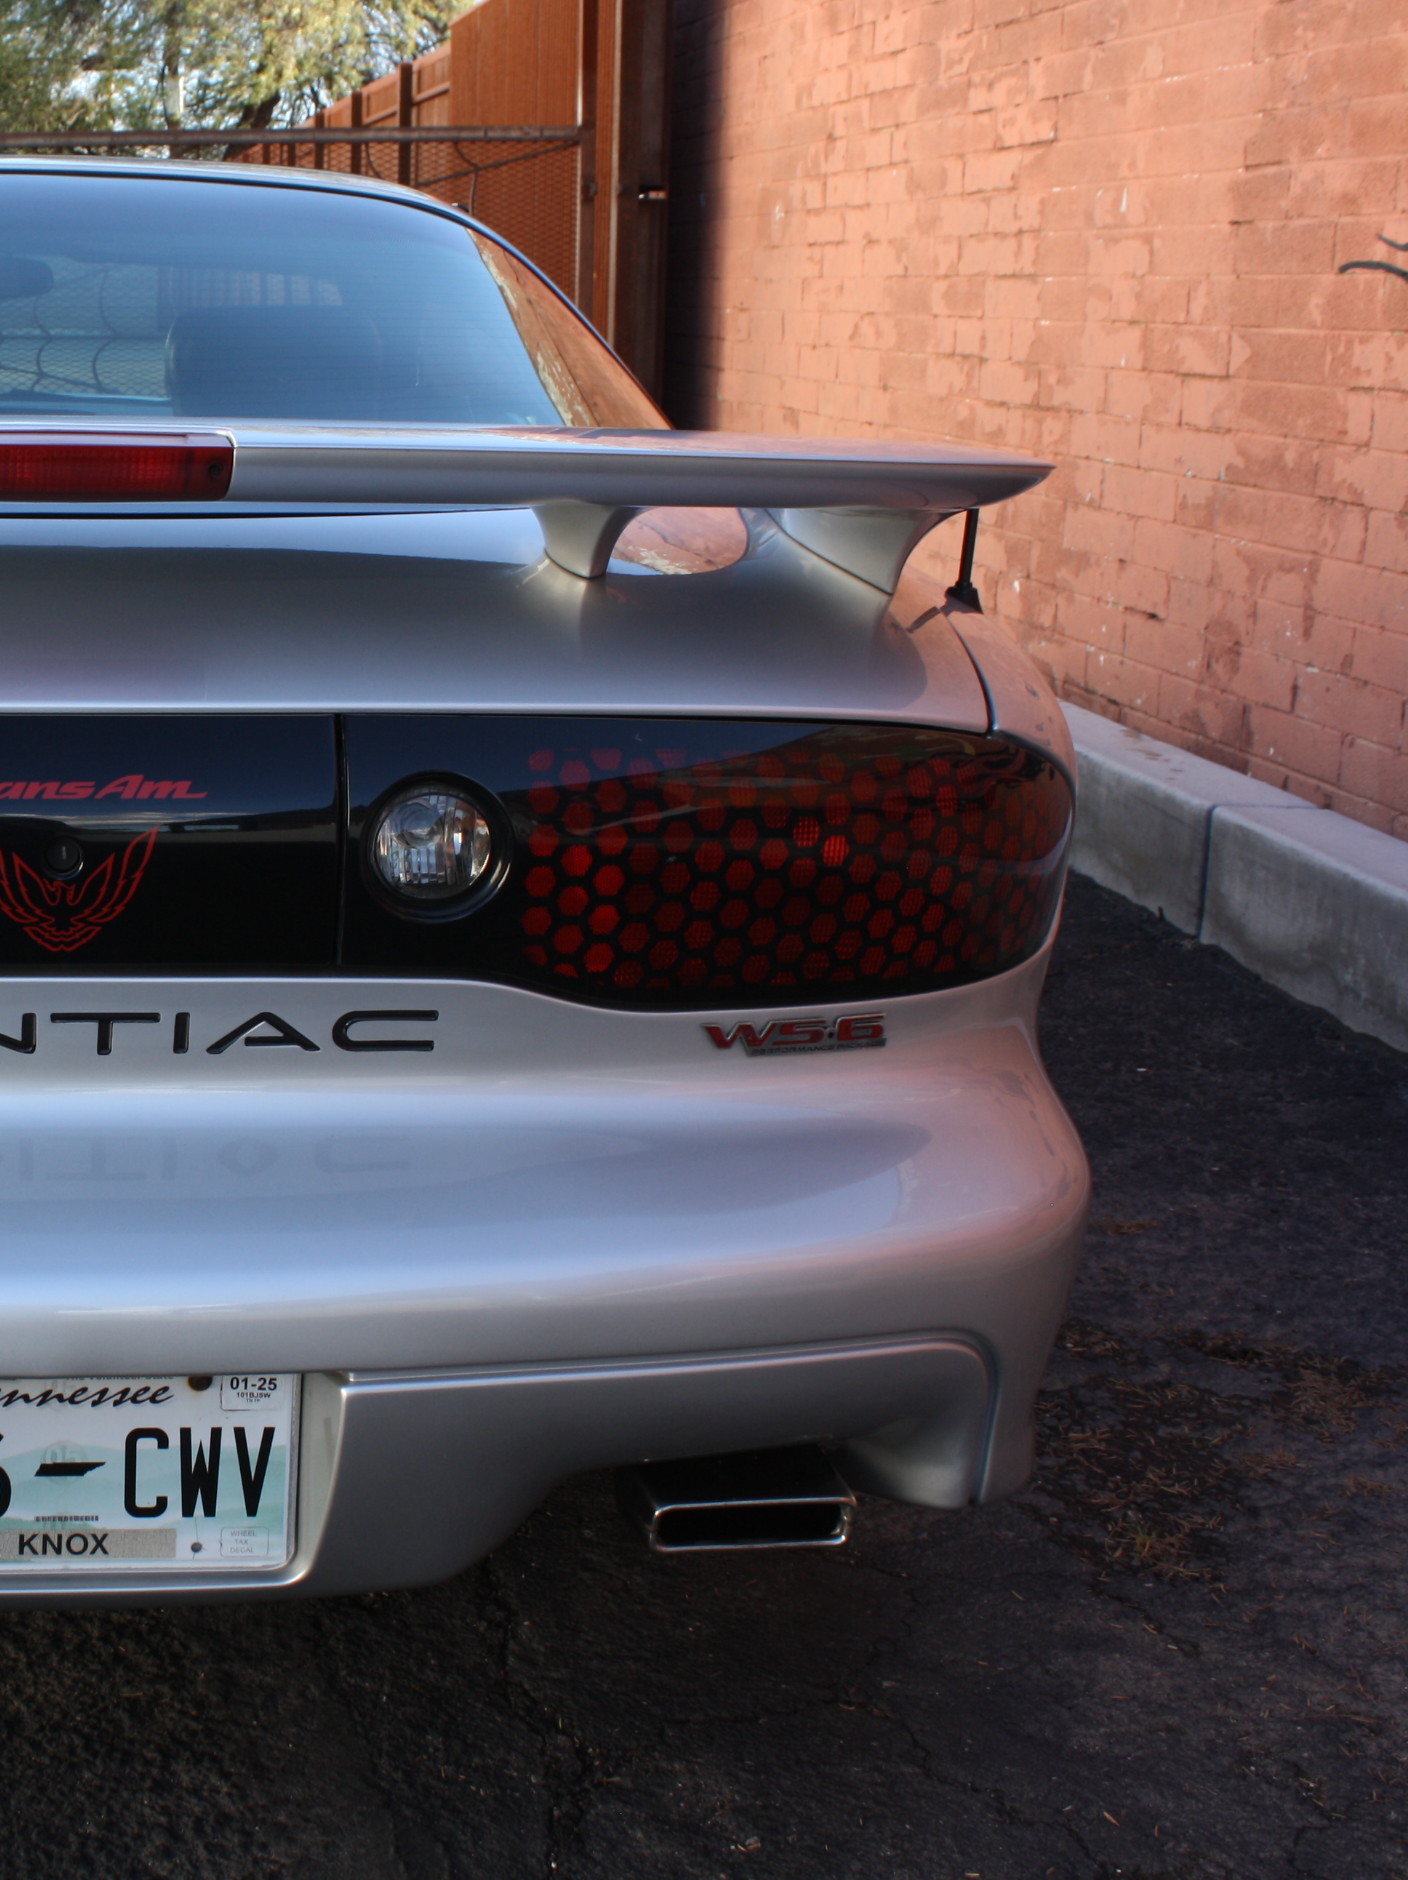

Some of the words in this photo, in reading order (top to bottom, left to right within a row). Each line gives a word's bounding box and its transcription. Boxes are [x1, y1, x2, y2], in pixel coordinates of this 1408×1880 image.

[230, 1377, 278, 1391] 01-25
[124, 1426, 276, 1518] CWV
[18, 1533, 109, 1555] KNOX
